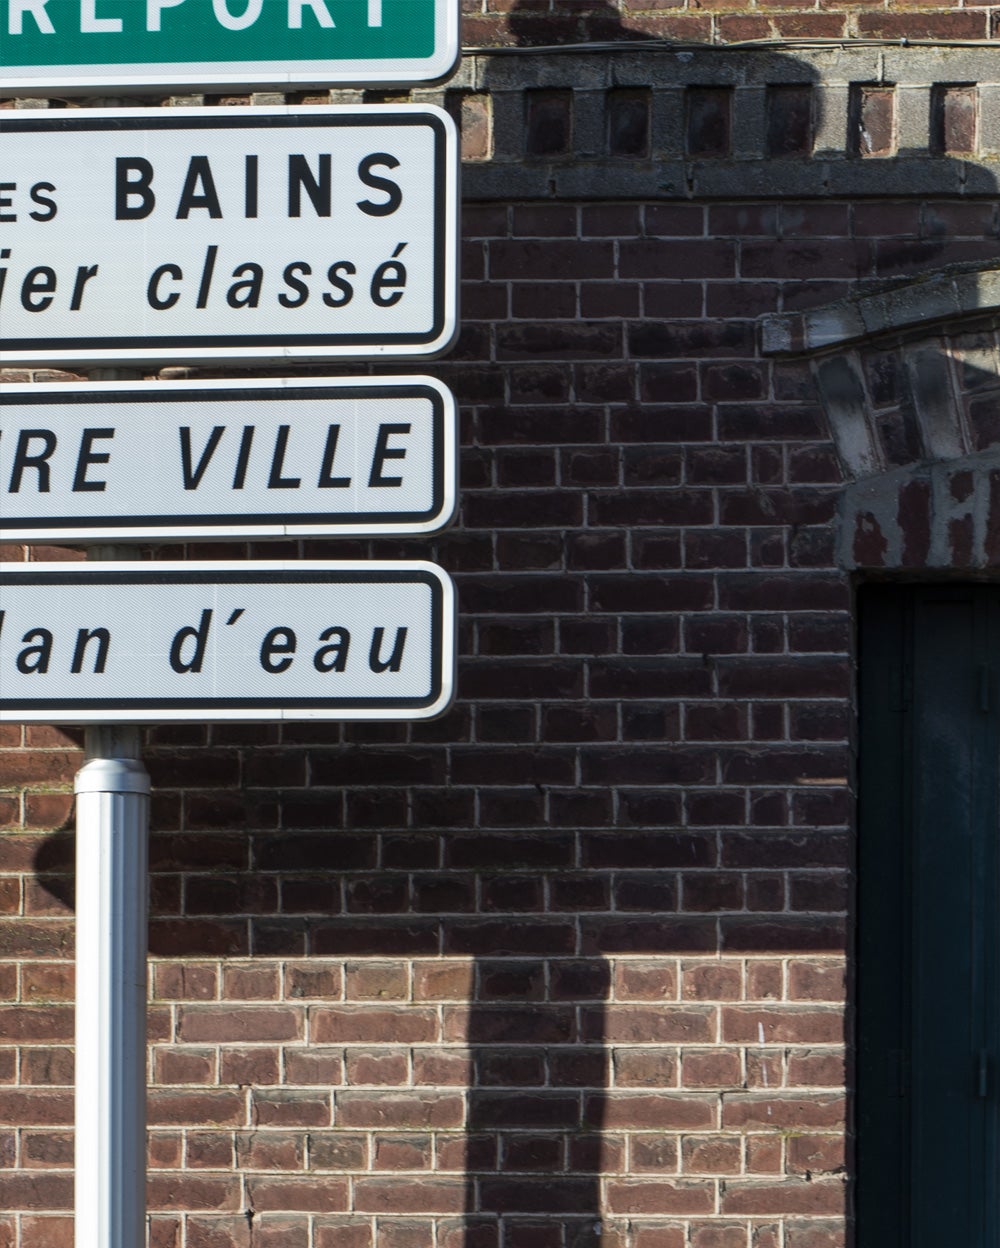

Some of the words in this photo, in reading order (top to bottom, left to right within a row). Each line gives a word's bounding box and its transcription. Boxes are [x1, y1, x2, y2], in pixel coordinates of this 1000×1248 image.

[115, 153, 403, 221] BAINS
[146, 242, 408, 312] classé
[0, 427, 116, 494] RE
[178, 422, 412, 491] VILLE
[0, 609, 111, 675] an
[169, 608, 408, 675] d'eau
